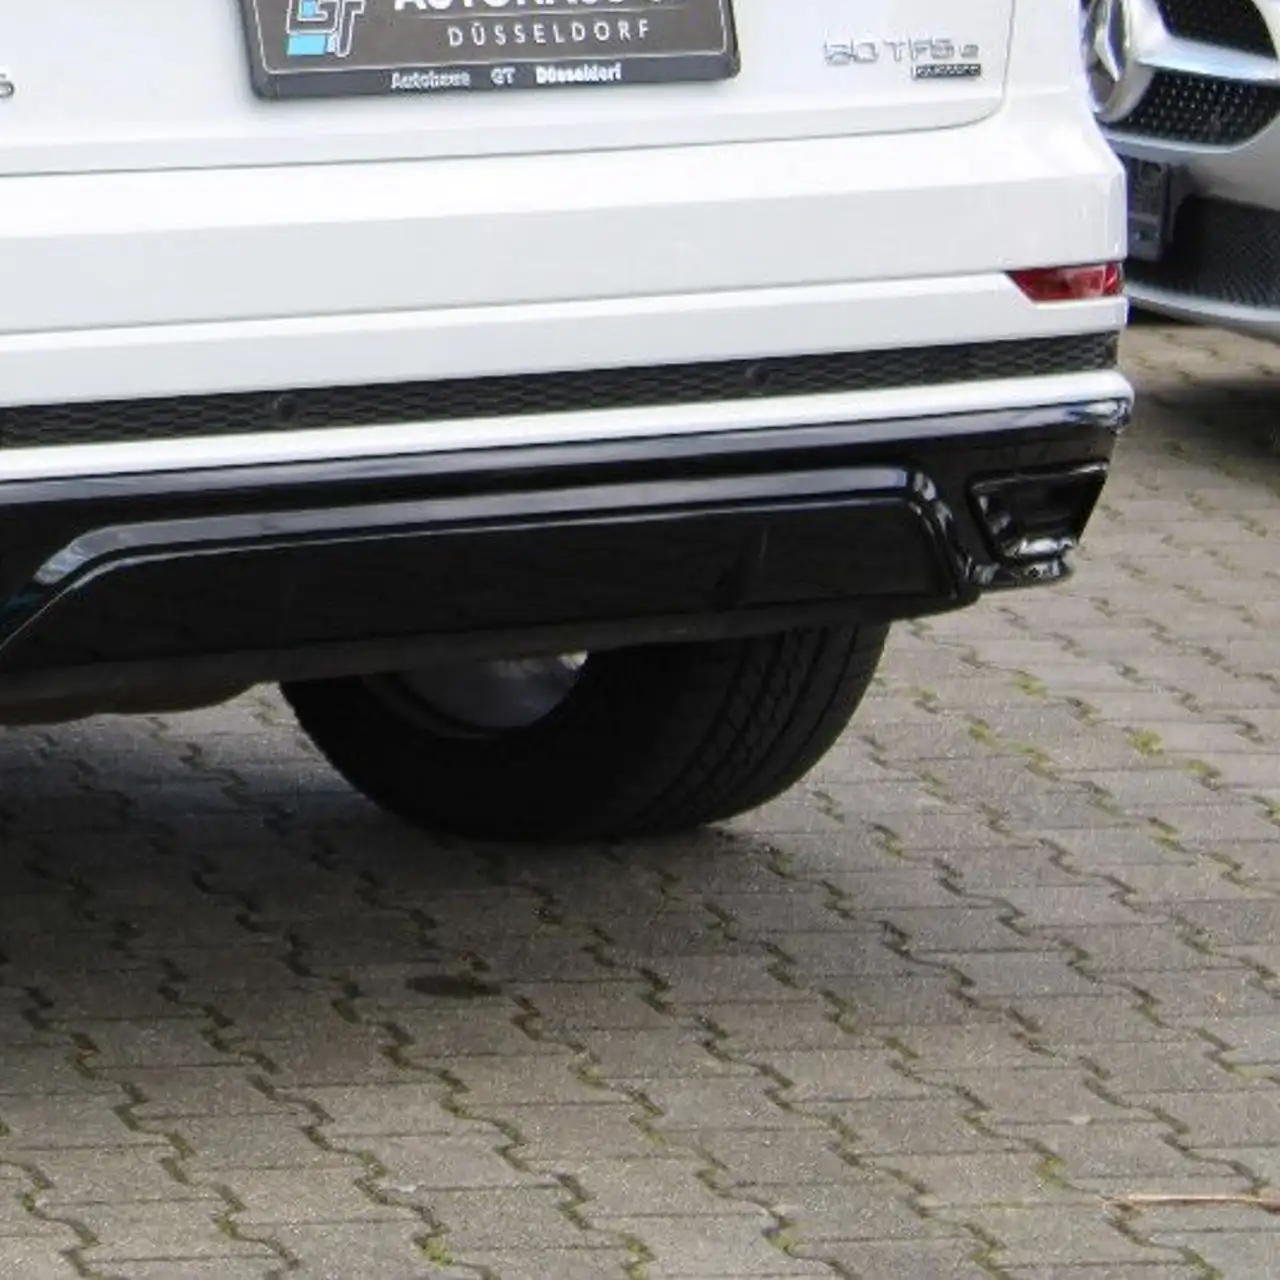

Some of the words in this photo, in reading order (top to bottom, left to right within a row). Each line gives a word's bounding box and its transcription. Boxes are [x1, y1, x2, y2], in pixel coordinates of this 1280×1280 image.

[447, 19, 650, 48] DÜSSELDORF
[390, 69, 471, 90] Autohaus
[490, 67, 517, 86] GT
[535, 62, 623, 85] Düsseldorf
